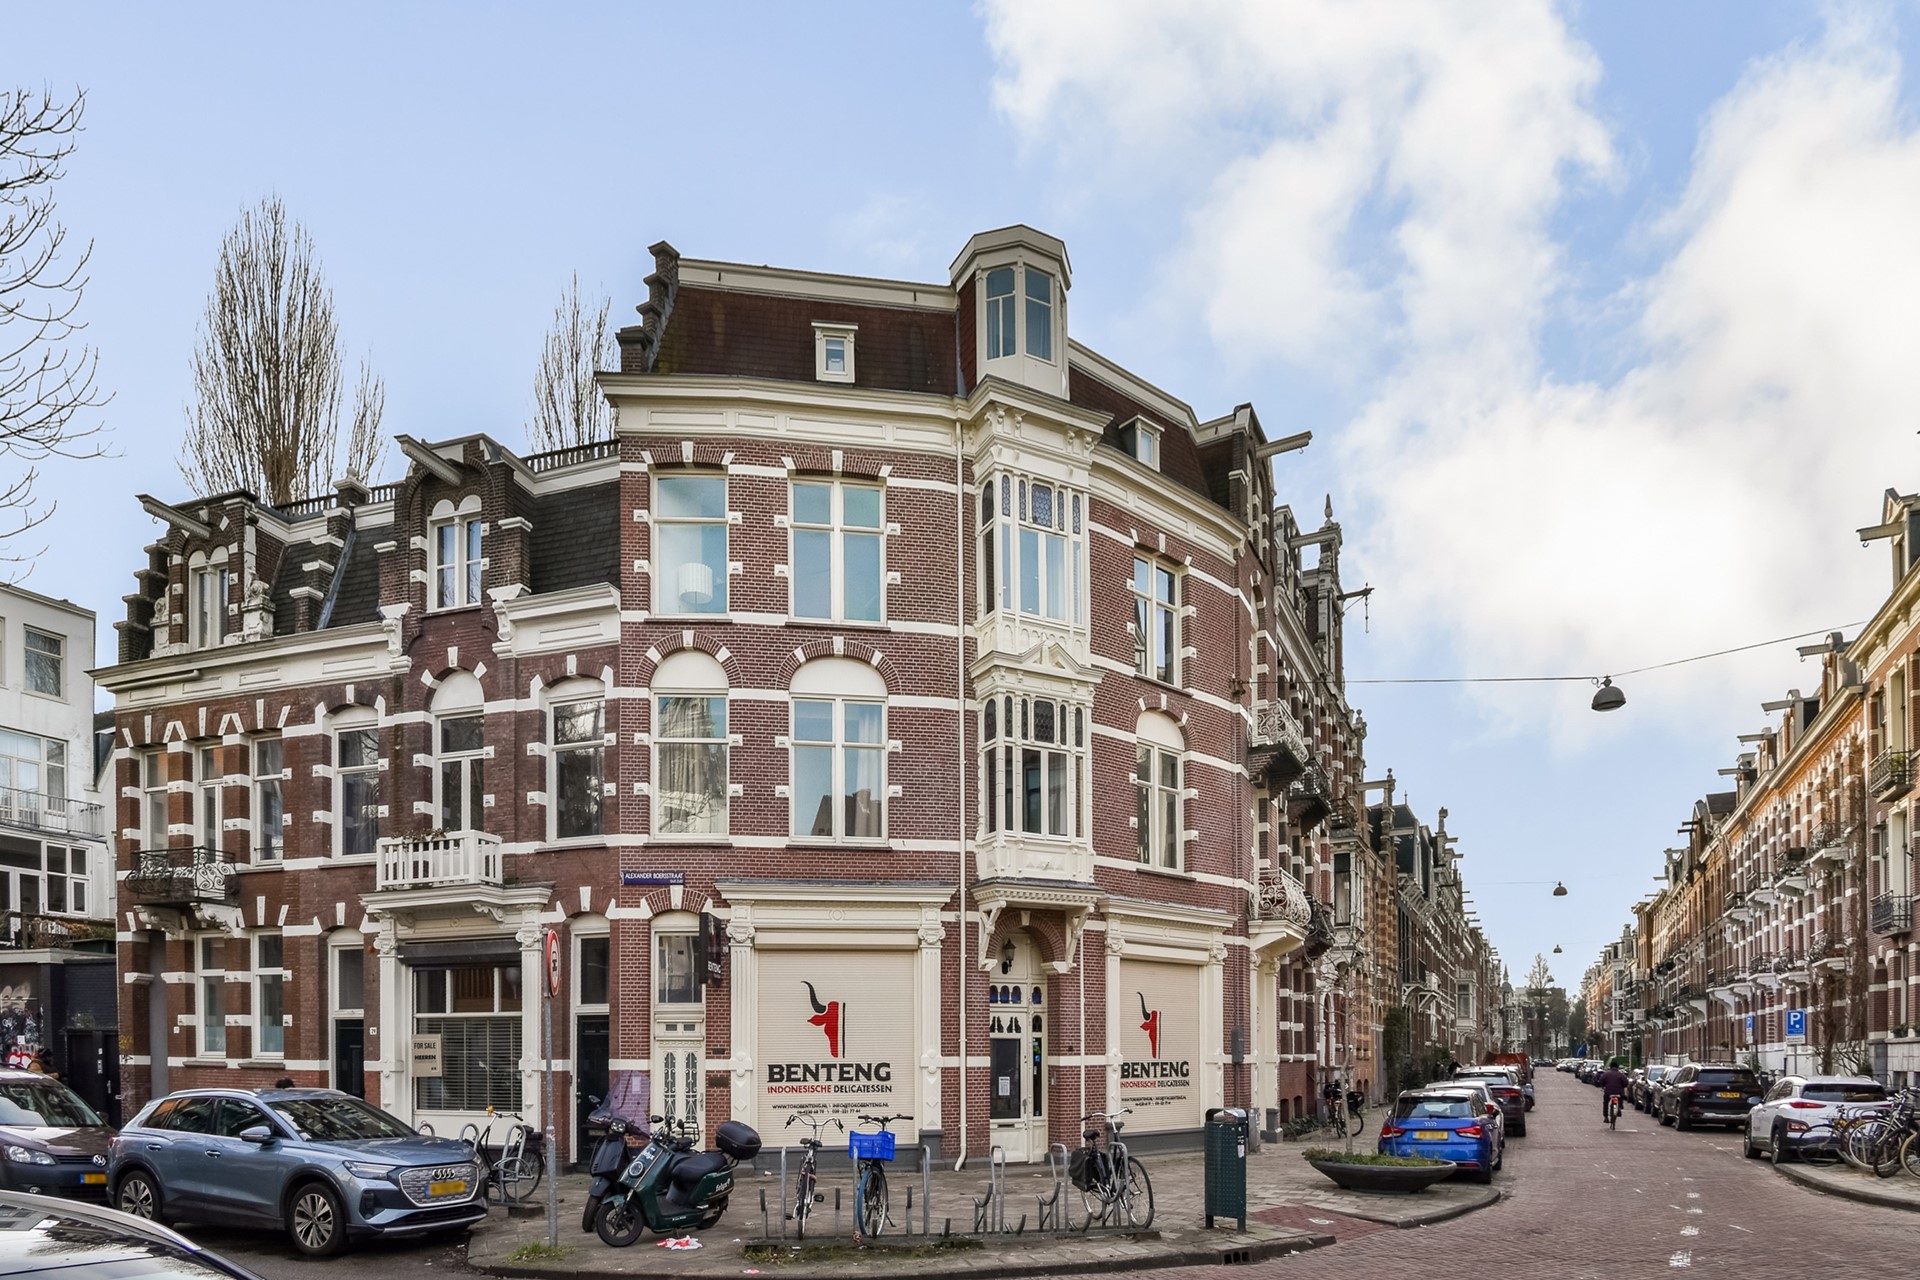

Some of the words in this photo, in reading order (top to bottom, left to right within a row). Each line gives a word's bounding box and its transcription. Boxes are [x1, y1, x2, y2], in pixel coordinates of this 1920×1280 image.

[1790, 1012, 1800, 1025] P
[767, 1062, 891, 1082] BENTENG
[1120, 1060, 1189, 1078] BENTENG
[767, 1084, 832, 1094] INDONESISCHE
[834, 1084, 892, 1093] DELICATESSEN
